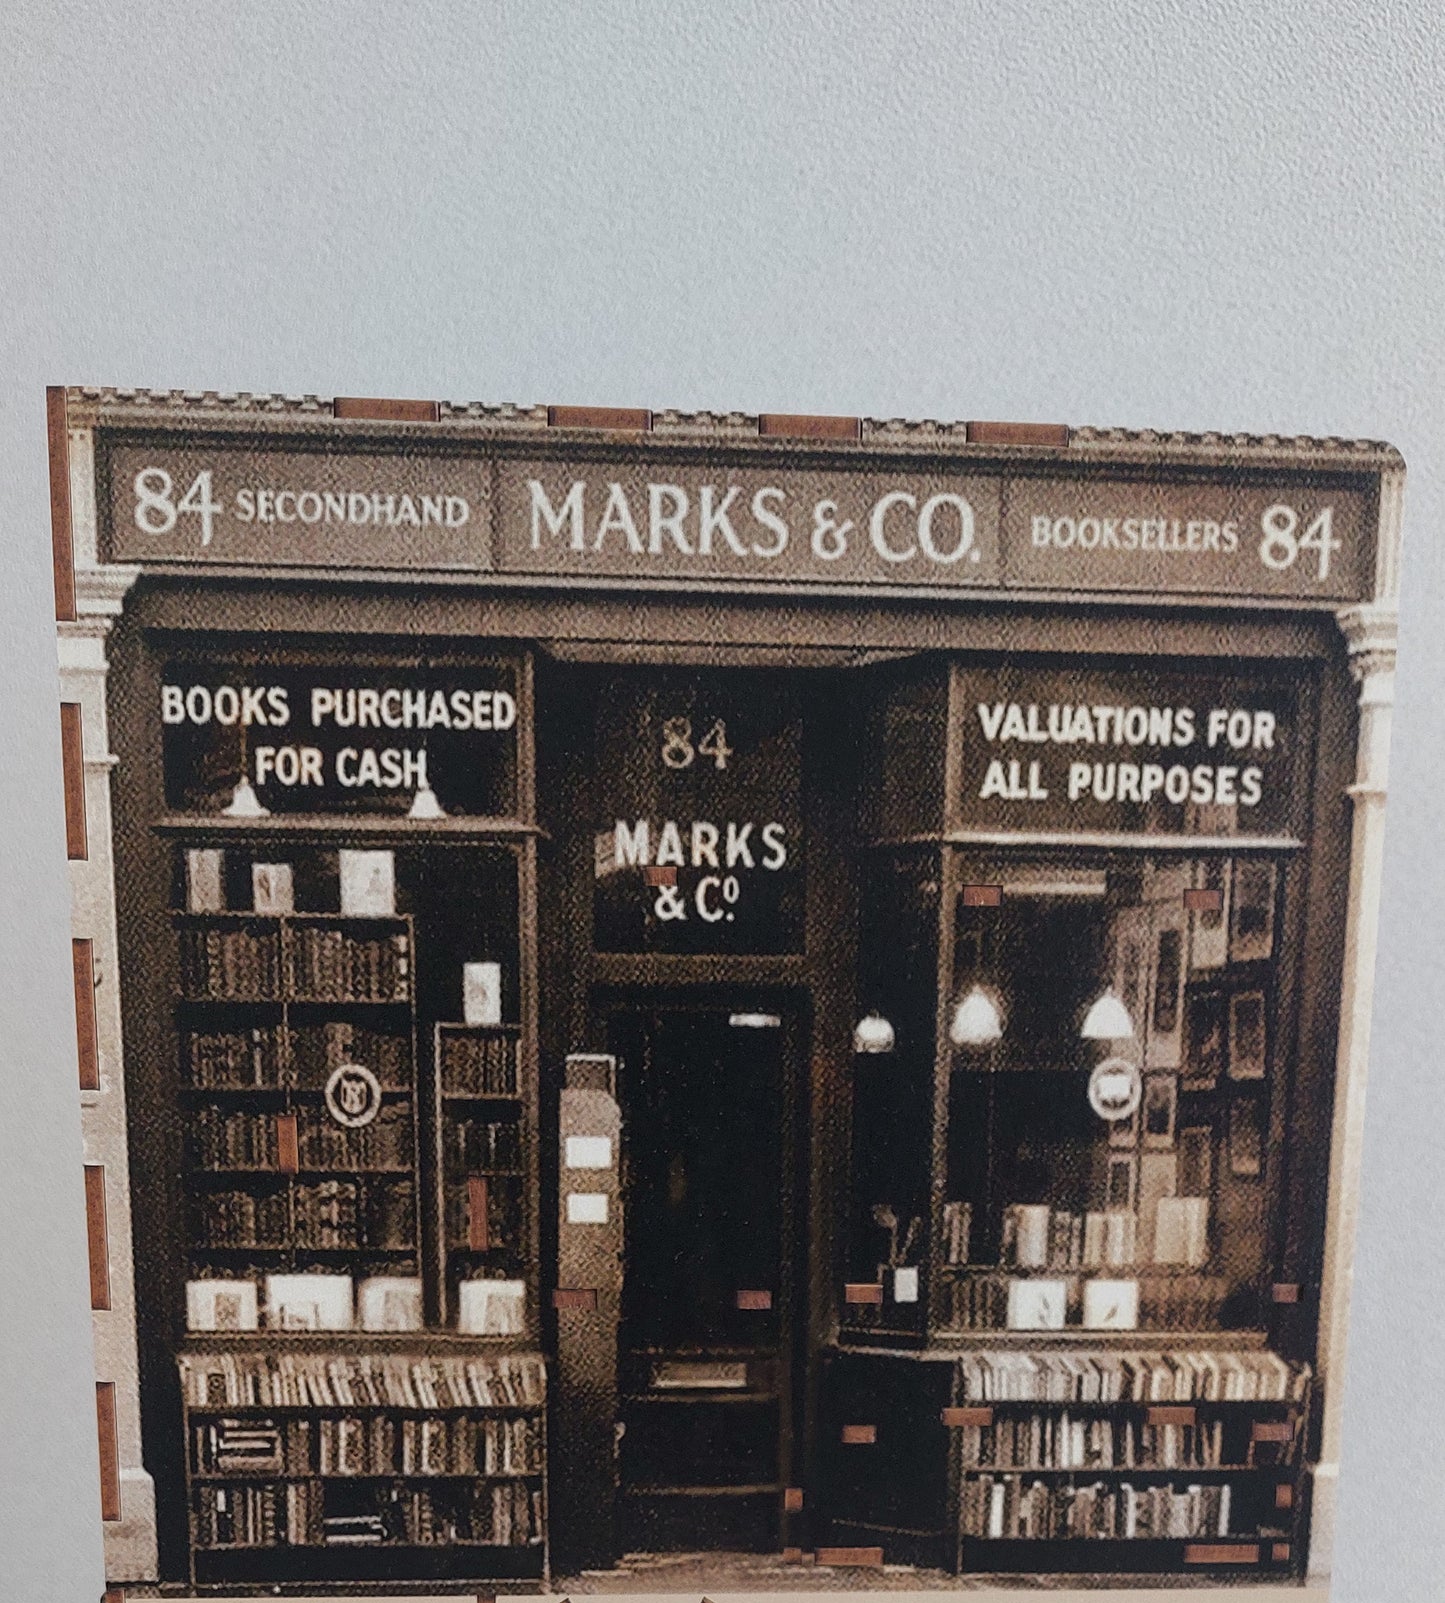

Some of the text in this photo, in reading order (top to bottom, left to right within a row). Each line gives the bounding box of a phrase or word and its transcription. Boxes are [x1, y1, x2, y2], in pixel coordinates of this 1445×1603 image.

[132, 467, 222, 546] 84
[236, 487, 470, 529] SECONDHAND
[526, 479, 981, 565] MARKS & CO.
[1031, 516, 1239, 553] BOOKSELLERS
[1258, 505, 1341, 581] 84
[161, 685, 515, 730] BOOKS PURCHASED
[978, 703, 1275, 749] VALUATIONS FOR
[661, 716, 734, 769] 84
[255, 748, 427, 789] FOR CASH
[979, 761, 1262, 806] ALL PURPOSES
[613, 819, 787, 871] MARKS
[654, 885, 688, 921] &
